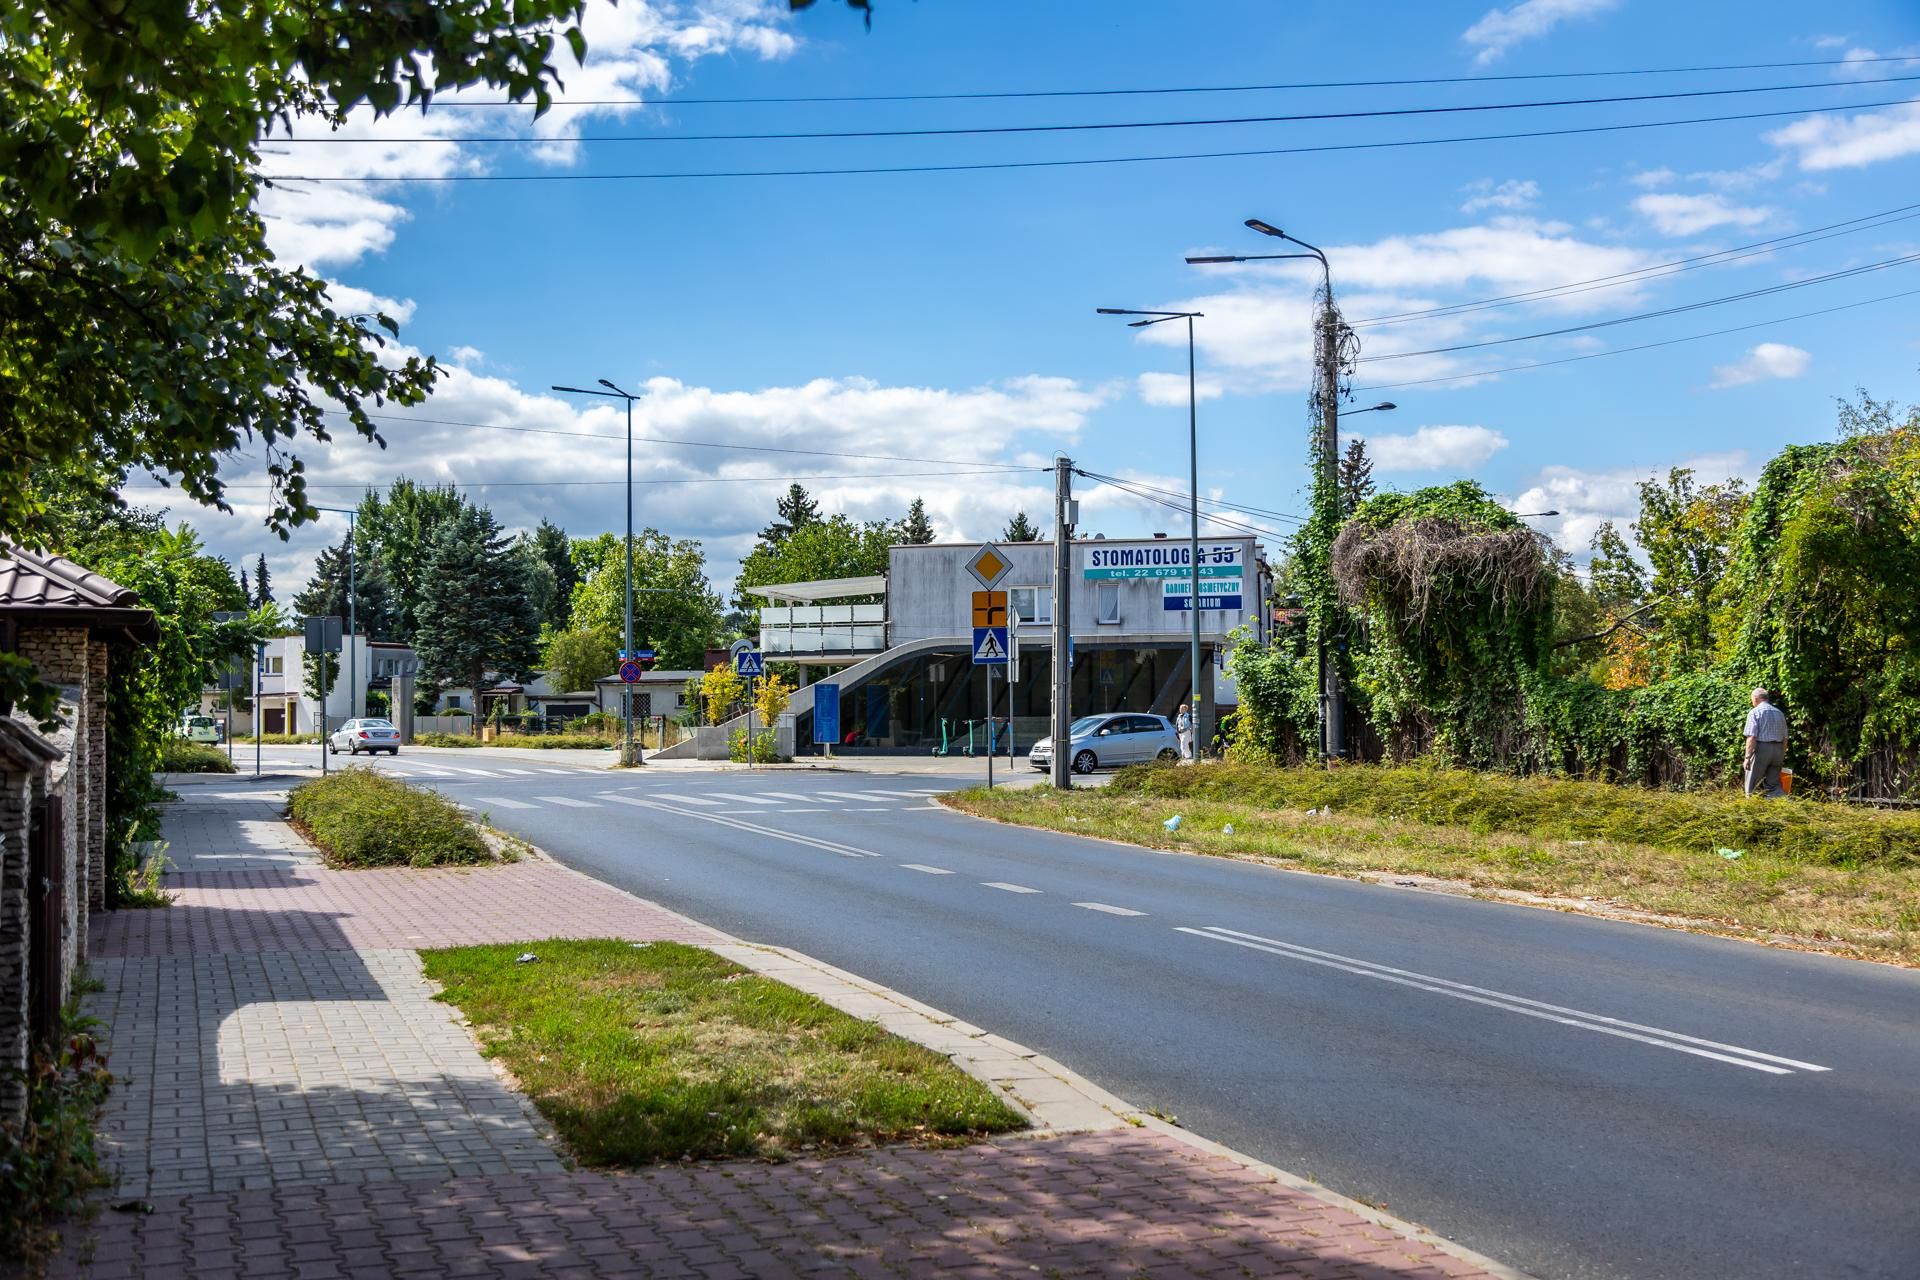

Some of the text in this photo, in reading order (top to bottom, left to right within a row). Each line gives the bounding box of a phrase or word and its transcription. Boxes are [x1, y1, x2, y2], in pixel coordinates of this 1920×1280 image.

[1092, 546, 1234, 567] STOMATOLOGA 55
[1134, 569, 1149, 577] 22
[1199, 567, 1214, 575] 43
[1198, 582, 1240, 593] OSMETYCZNY
[1184, 597, 1221, 609] SOARIUM
